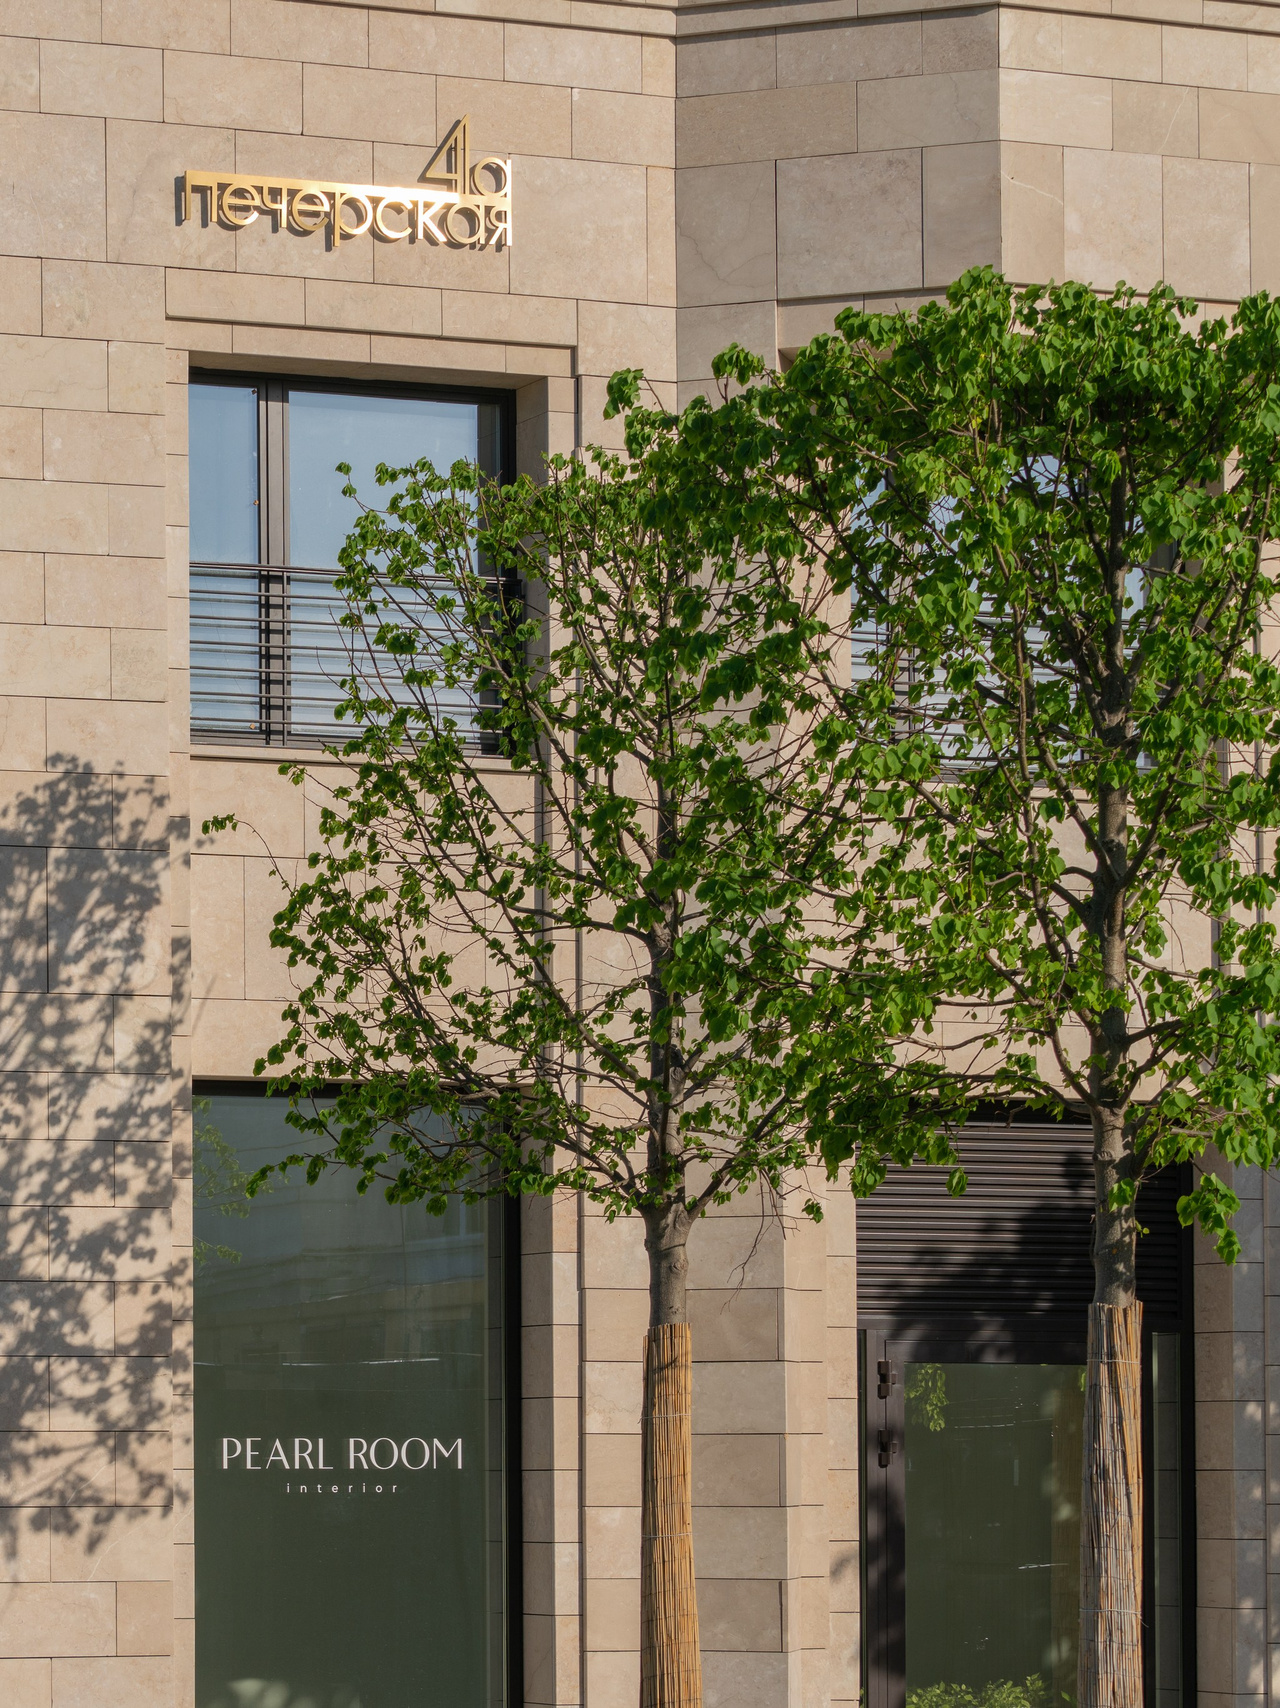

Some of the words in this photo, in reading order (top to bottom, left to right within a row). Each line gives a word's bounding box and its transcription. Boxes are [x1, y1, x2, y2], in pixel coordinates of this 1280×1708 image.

[221, 1437, 334, 1470] PEARL
[348, 1437, 463, 1470] ROOM
[286, 1482, 398, 1494] interior
